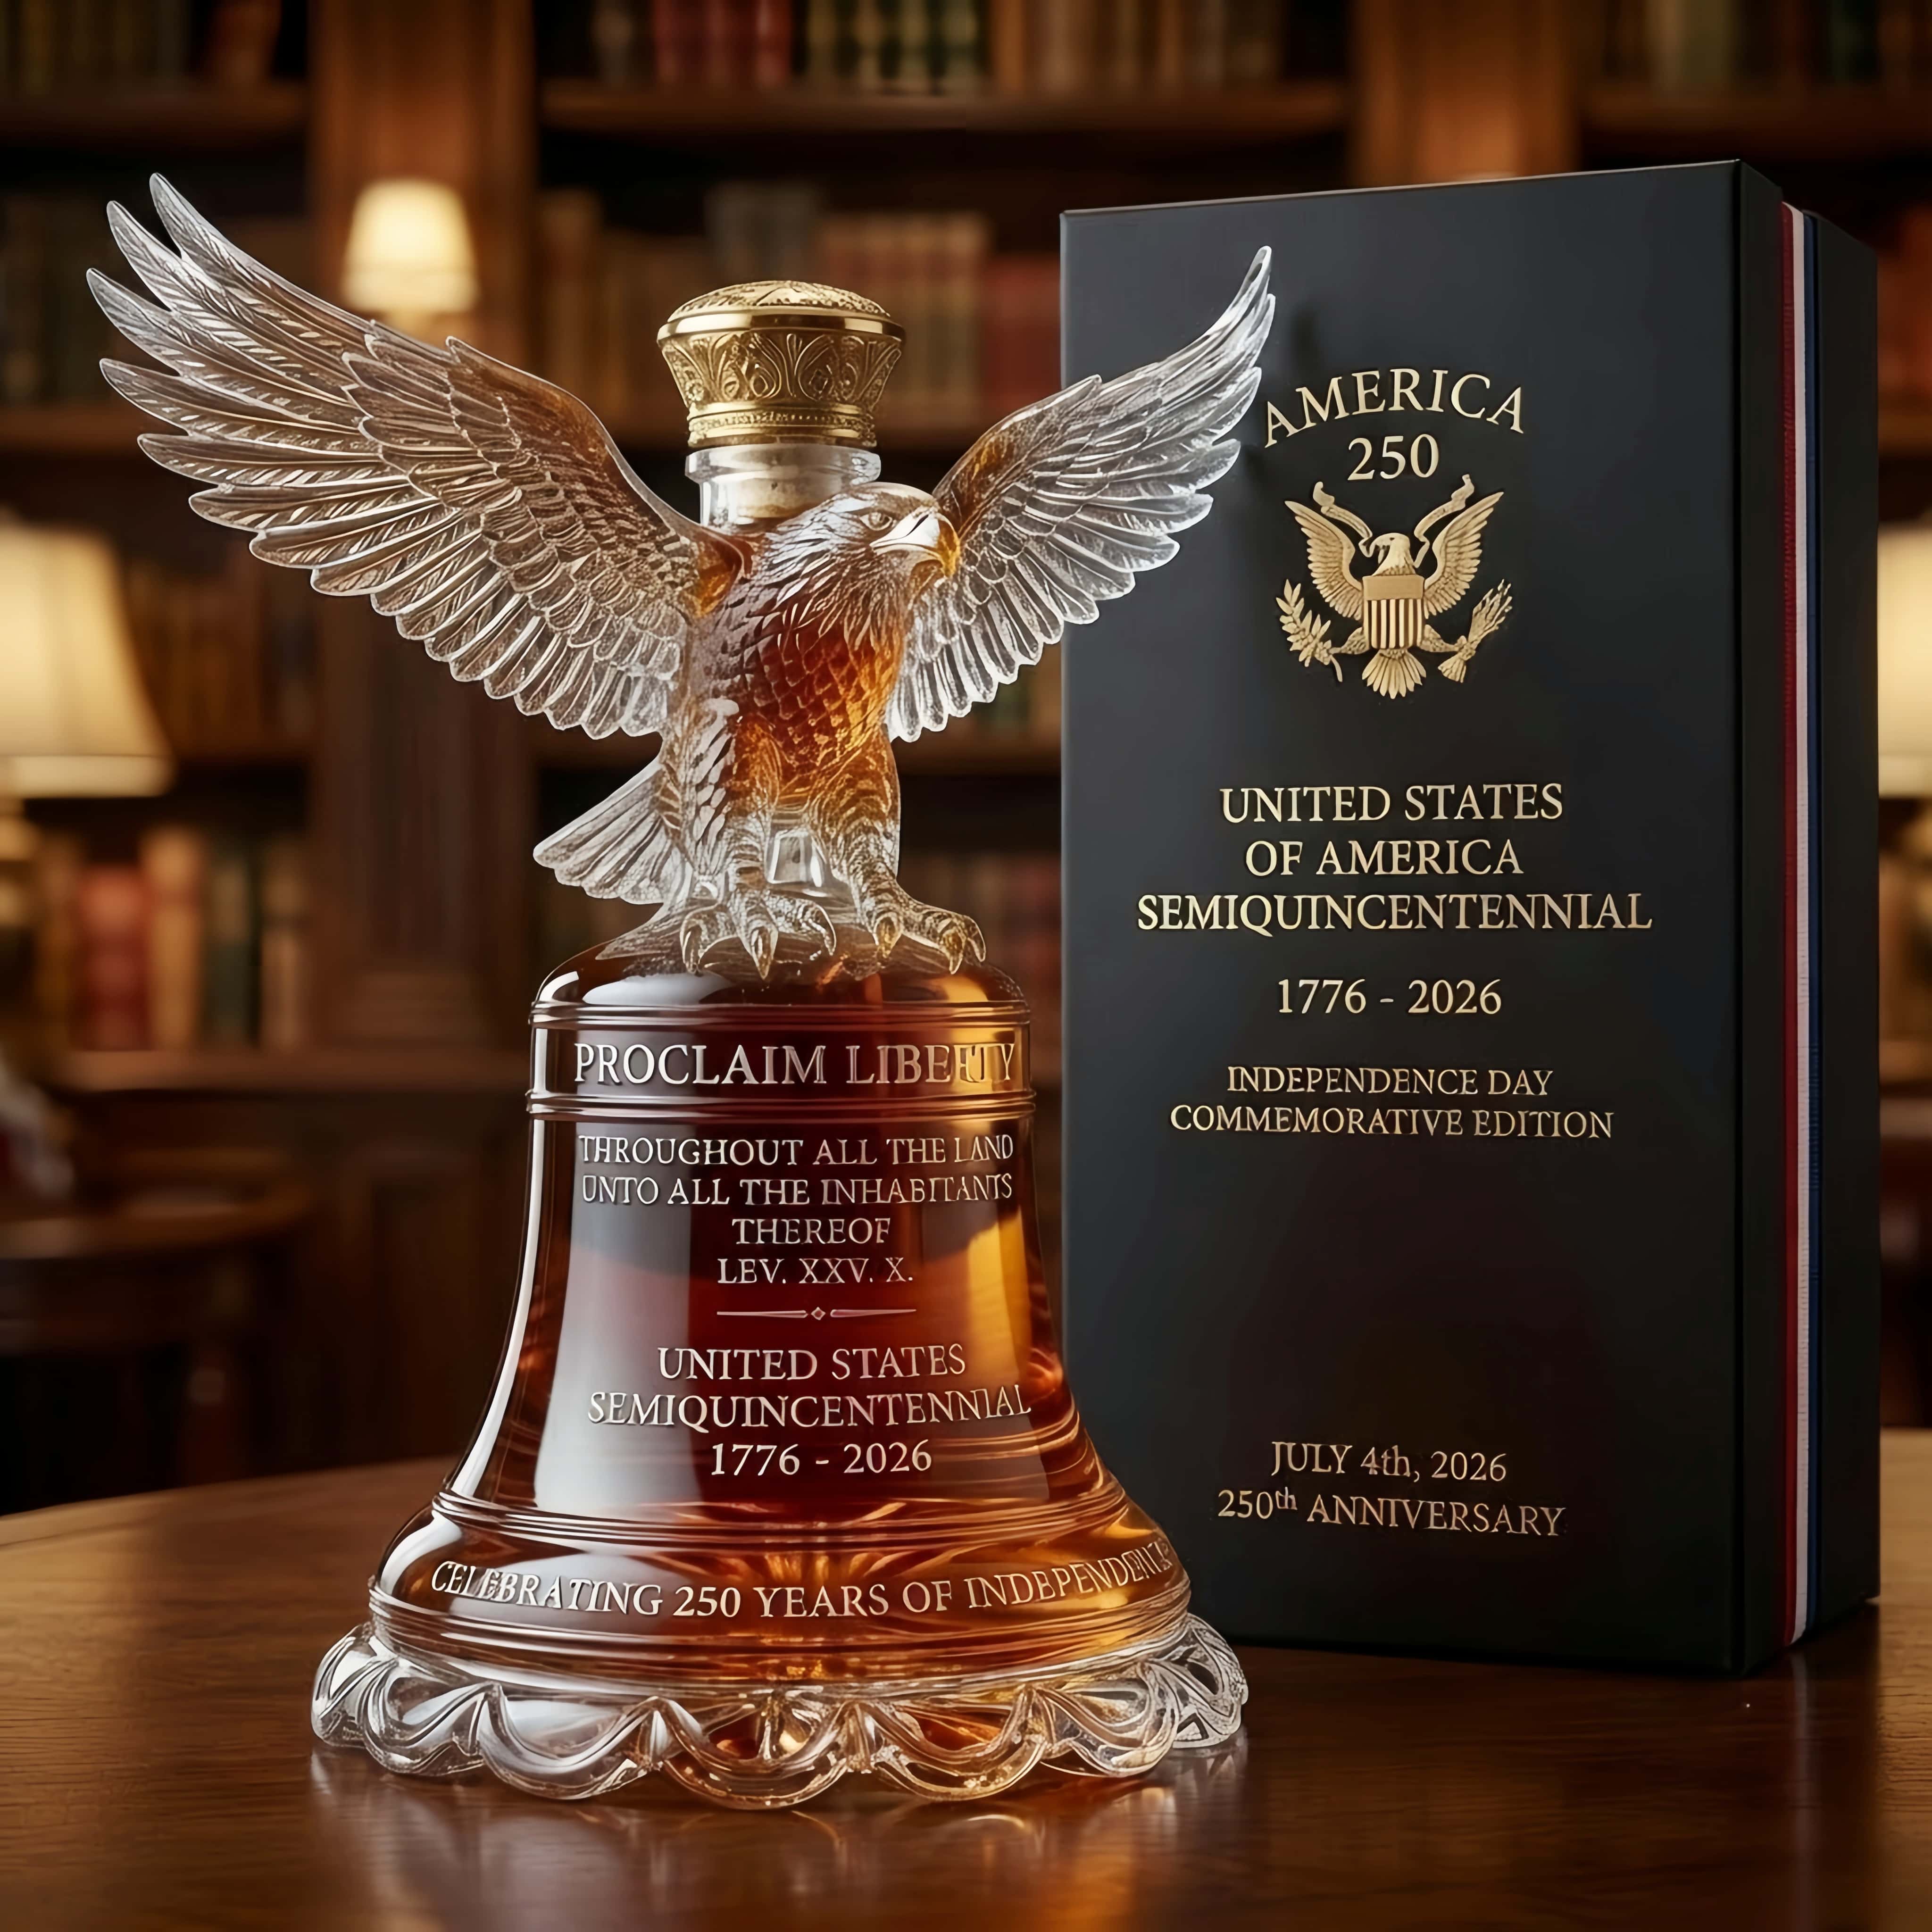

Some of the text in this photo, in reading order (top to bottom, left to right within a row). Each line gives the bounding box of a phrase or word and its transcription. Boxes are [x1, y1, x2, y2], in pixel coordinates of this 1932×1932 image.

[1264, 368, 1524, 449] AMERICA
[1348, 433, 1439, 481] 250
[1220, 783, 1563, 823] UNITED STATES
[1245, 839, 1524, 876] OF AMERICA
[1137, 893, 1652, 937] SEMIQUINCENTENNIAL
[1278, 979, 1366, 1014] 1776
[1407, 979, 1502, 1014] 2026
[575, 1043, 827, 1085] PROCLAIM
[1227, 1066, 1553, 1096] INDEPENDENCE DAY
[1170, 1105, 1614, 1139] COMMEMORATIVE EDITION
[579, 1134, 1014, 1166] THROUGHOUT ALL THE LAND
[582, 1173, 1013, 1206] UNTO ALL THE INHABITANTS
[732, 1216, 891, 1245] THEREOF
[717, 1257, 913, 1284] LEV. XXV. X.
[658, 1343, 966, 1381] UNITED STATES
[588, 1384, 1032, 1432] SEMIQUINCENTENNIAL
[711, 1443, 800, 1476] 1776
[844, 1439, 932, 1474] 2026
[1271, 1441, 1507, 1482] JULY 4th, 2026
[1307, 1494, 1566, 1536] ANNIVERSARY
[431, 1539, 1173, 1617] CELEBRATING 250 YEARS OF INDEPENDEN
